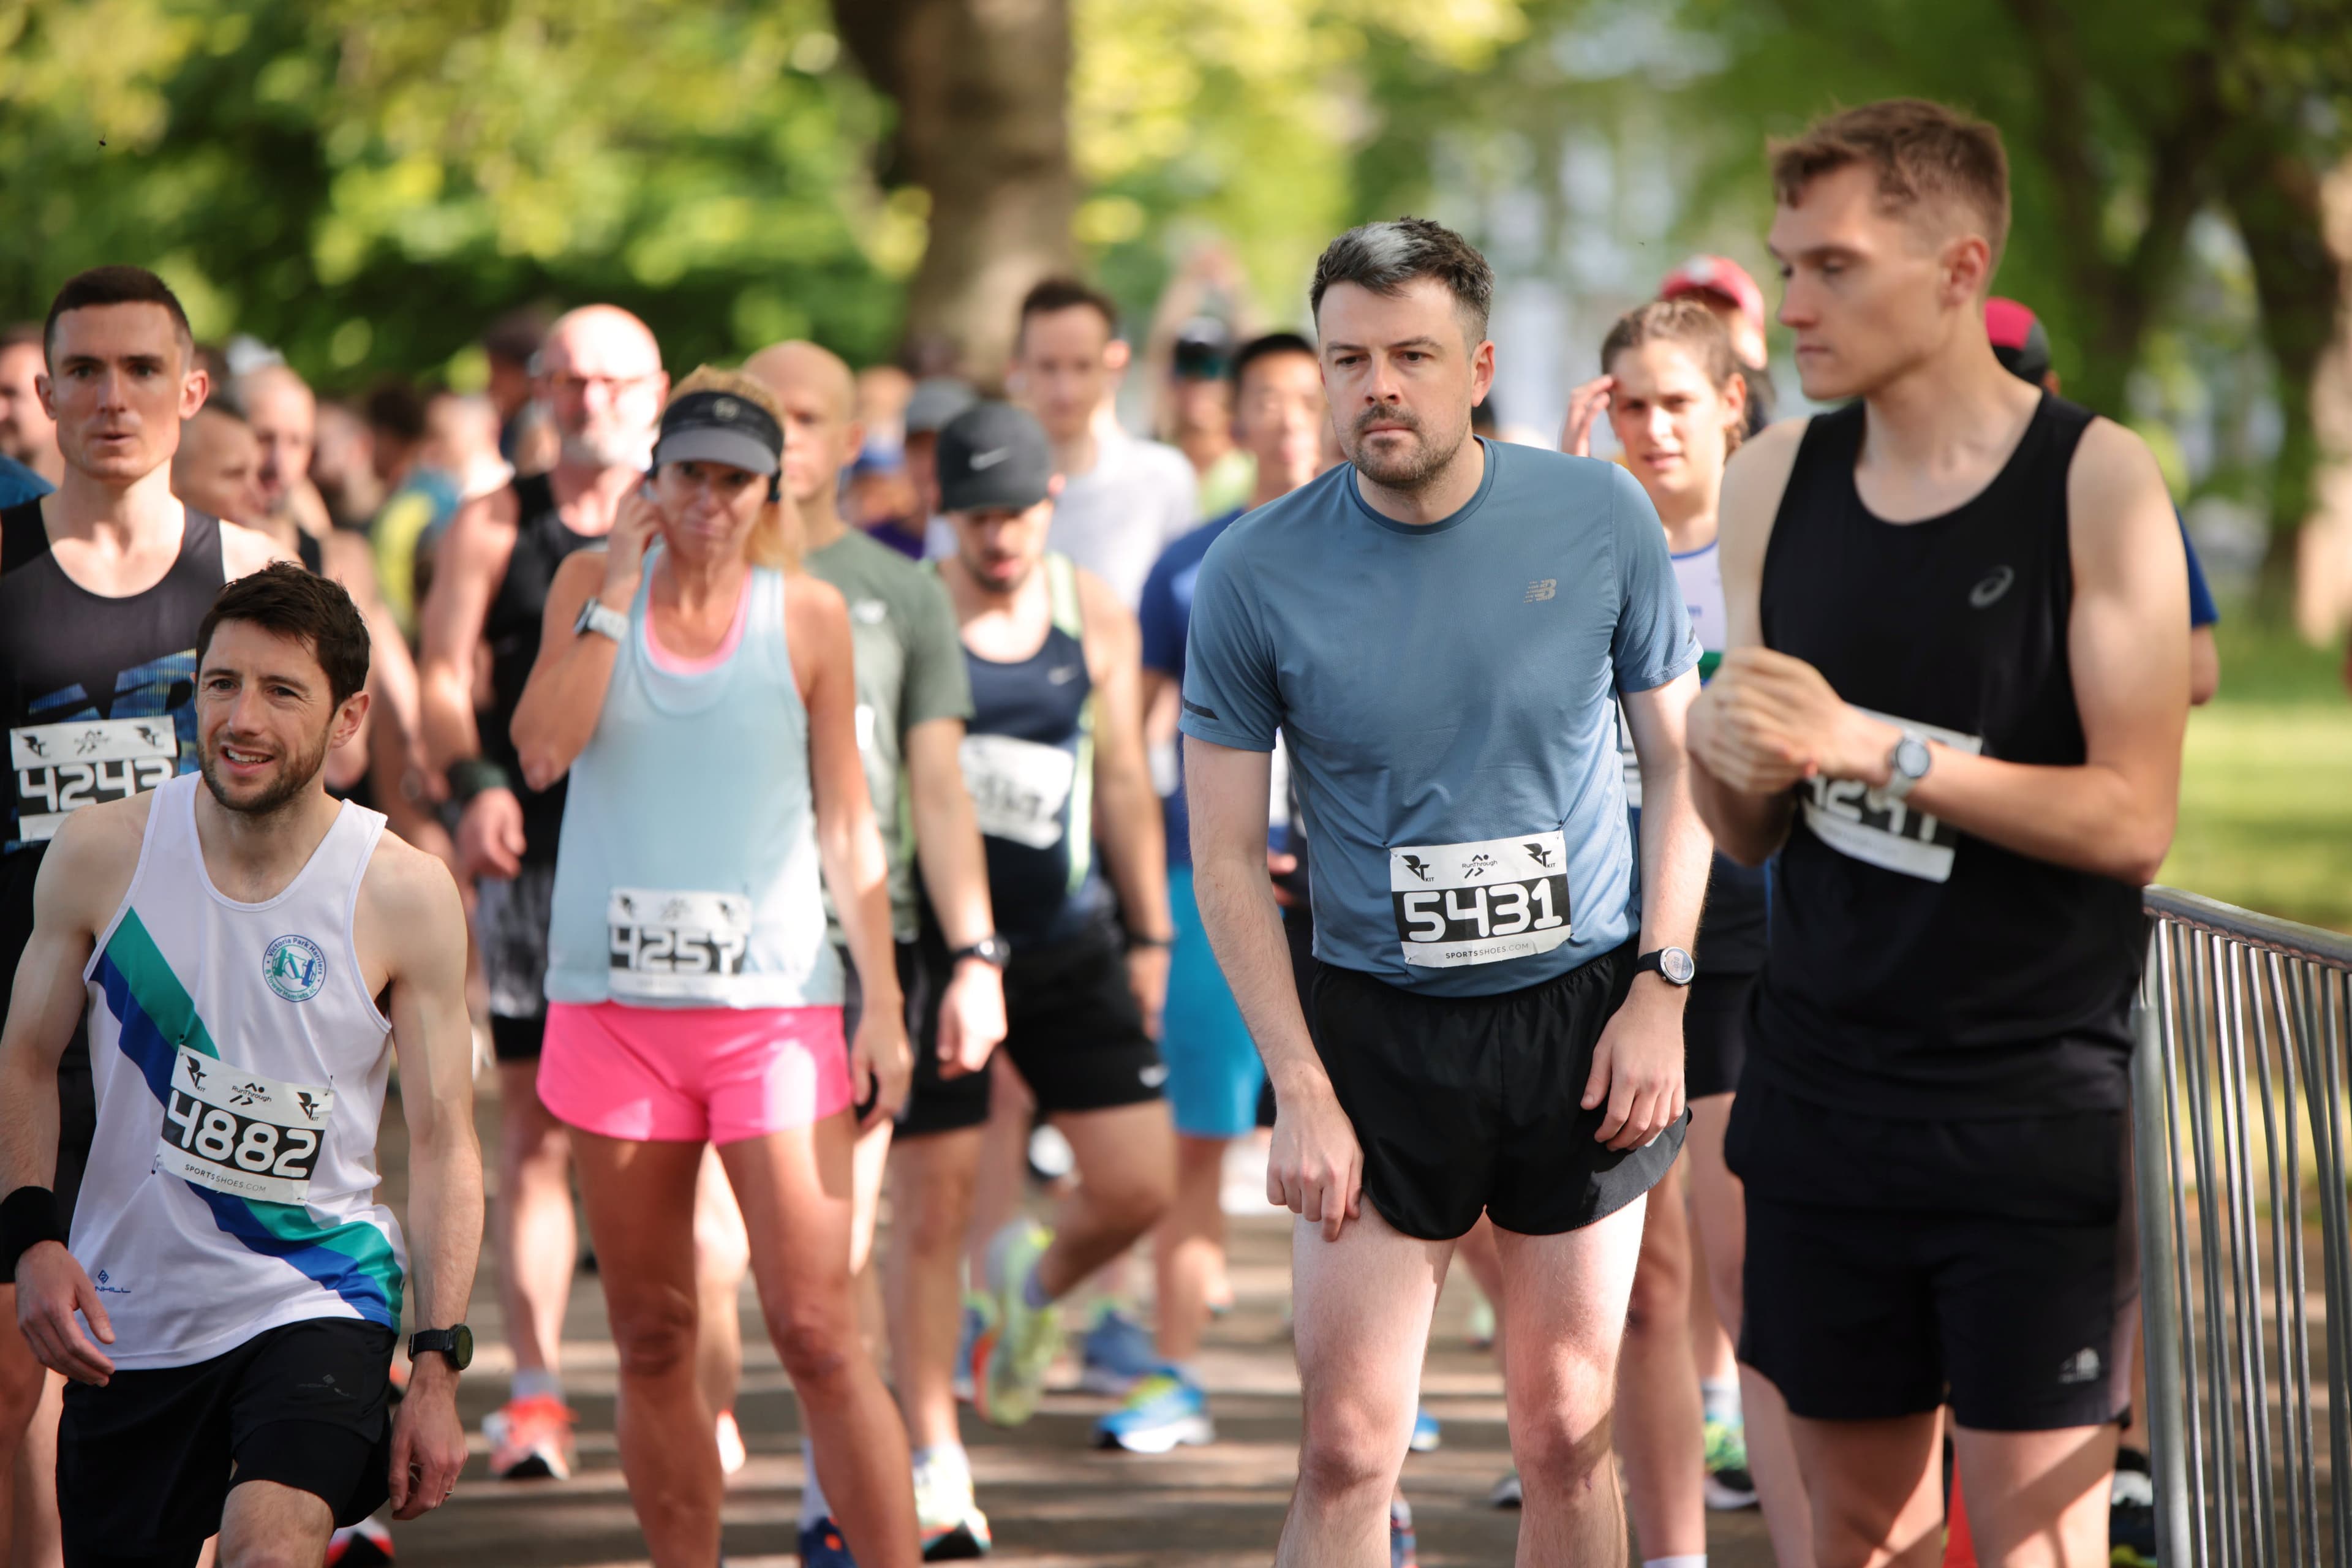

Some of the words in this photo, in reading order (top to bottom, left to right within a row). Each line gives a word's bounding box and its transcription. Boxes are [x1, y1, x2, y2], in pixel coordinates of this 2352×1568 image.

[1461, 859, 1498, 869] RunThrough
[1403, 878, 1563, 942] 5431
[267, 938, 292, 957] Victoria
[293, 938, 309, 948] Park
[309, 945, 323, 974] Harriers
[610, 925, 746, 975] 4257
[267, 974, 283, 993] Tower
[282, 990, 309, 1000] Hamlets
[231, 1085, 272, 1102] RunThrough
[167, 1089, 317, 1178] 4882
